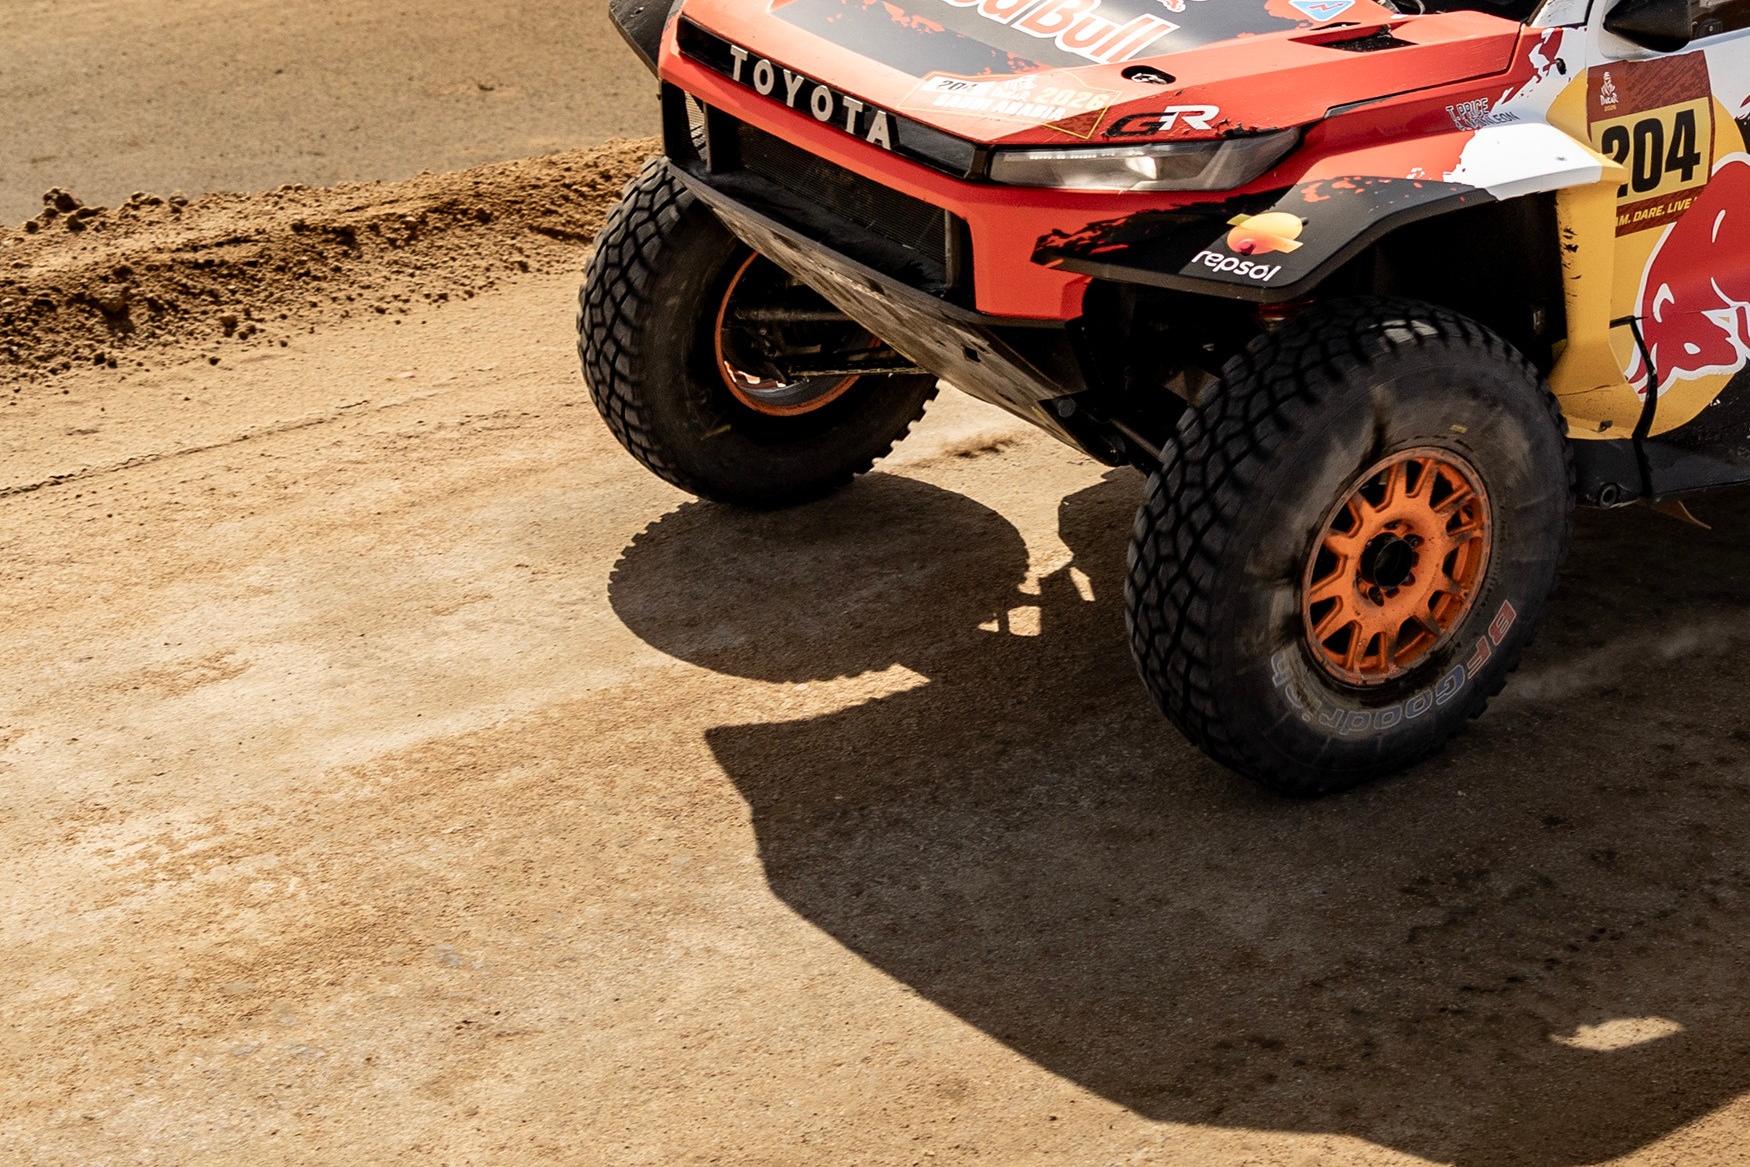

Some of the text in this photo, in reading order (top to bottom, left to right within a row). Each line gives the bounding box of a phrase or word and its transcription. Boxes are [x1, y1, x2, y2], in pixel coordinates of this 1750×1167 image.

[730, 44, 892, 150] TOYOTA
[990, 99, 1067, 121] ARABIA
[1033, 87, 1110, 111] 2026
[1101, 104, 1221, 138] GR
[1601, 108, 1701, 199] 204
[1633, 204, 1665, 222] DARE.
[1191, 250, 1282, 282] repsol
